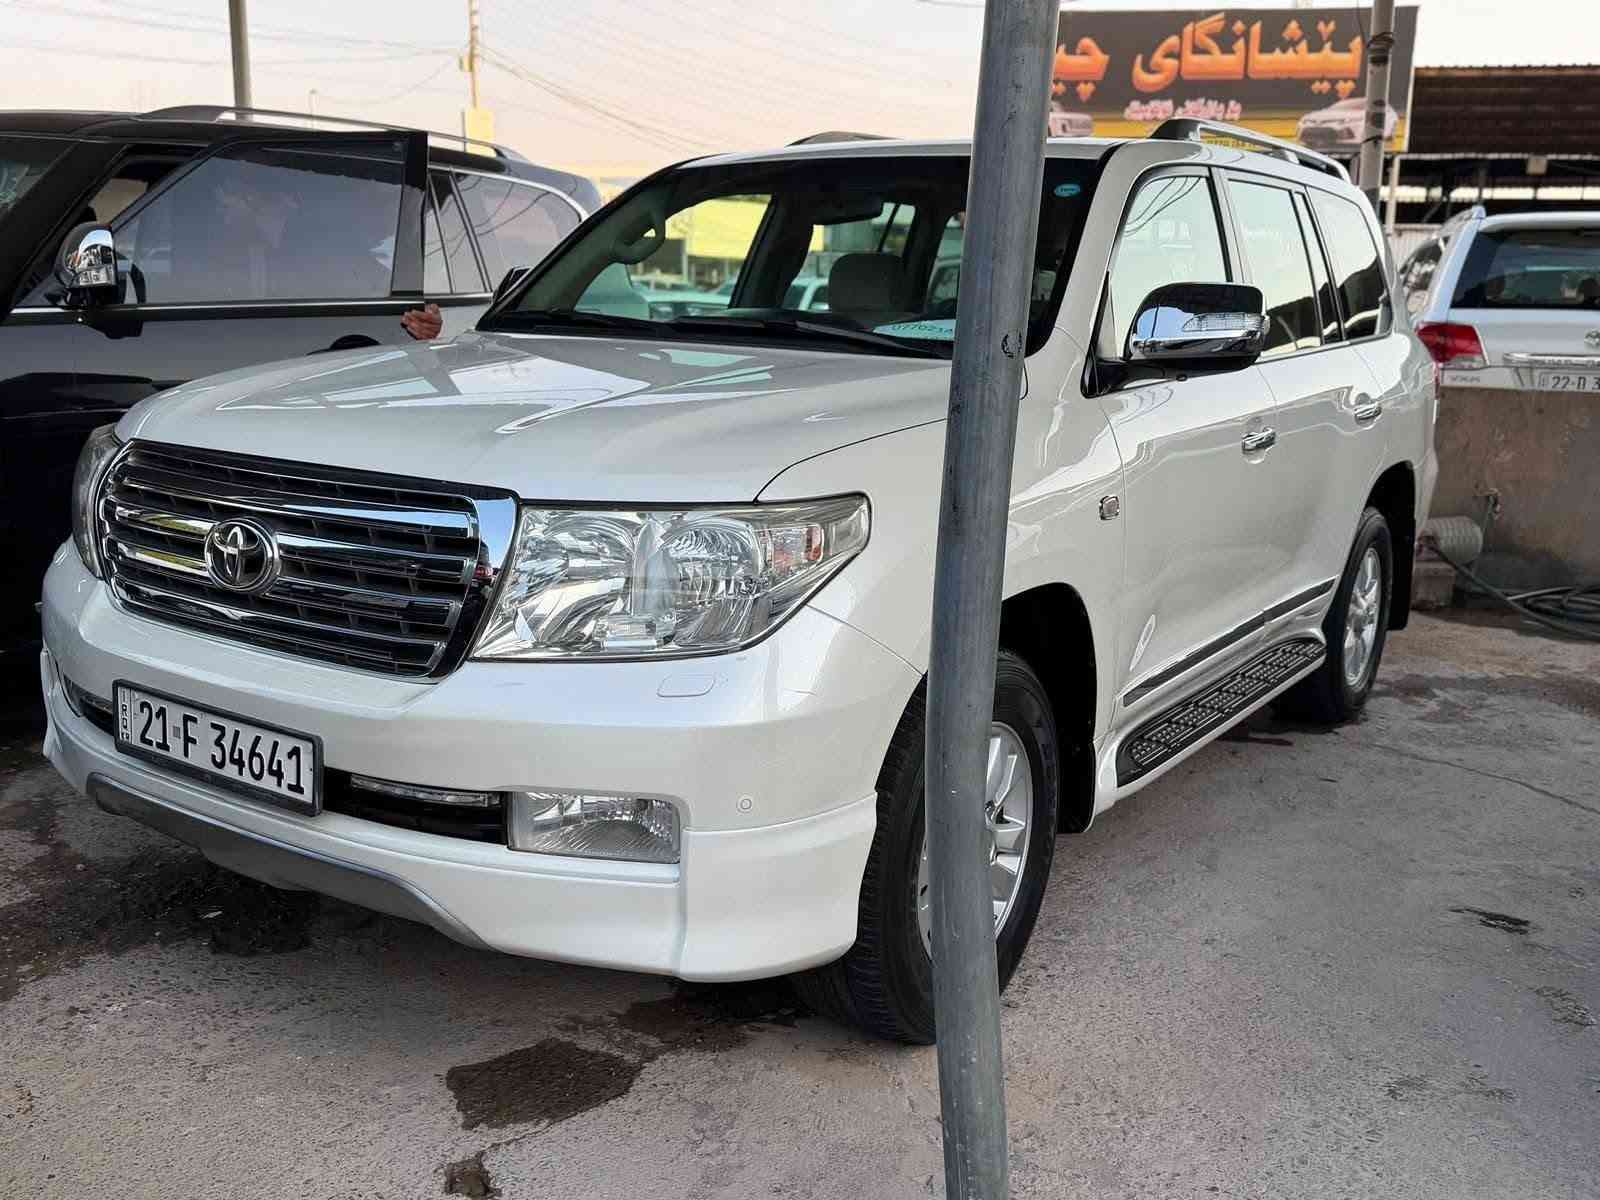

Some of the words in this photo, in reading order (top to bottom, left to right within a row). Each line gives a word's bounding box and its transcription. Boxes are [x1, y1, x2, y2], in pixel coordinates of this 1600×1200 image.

[138, 700, 170, 752] 21
[182, 713, 198, 758] F
[210, 722, 305, 795] 34641
